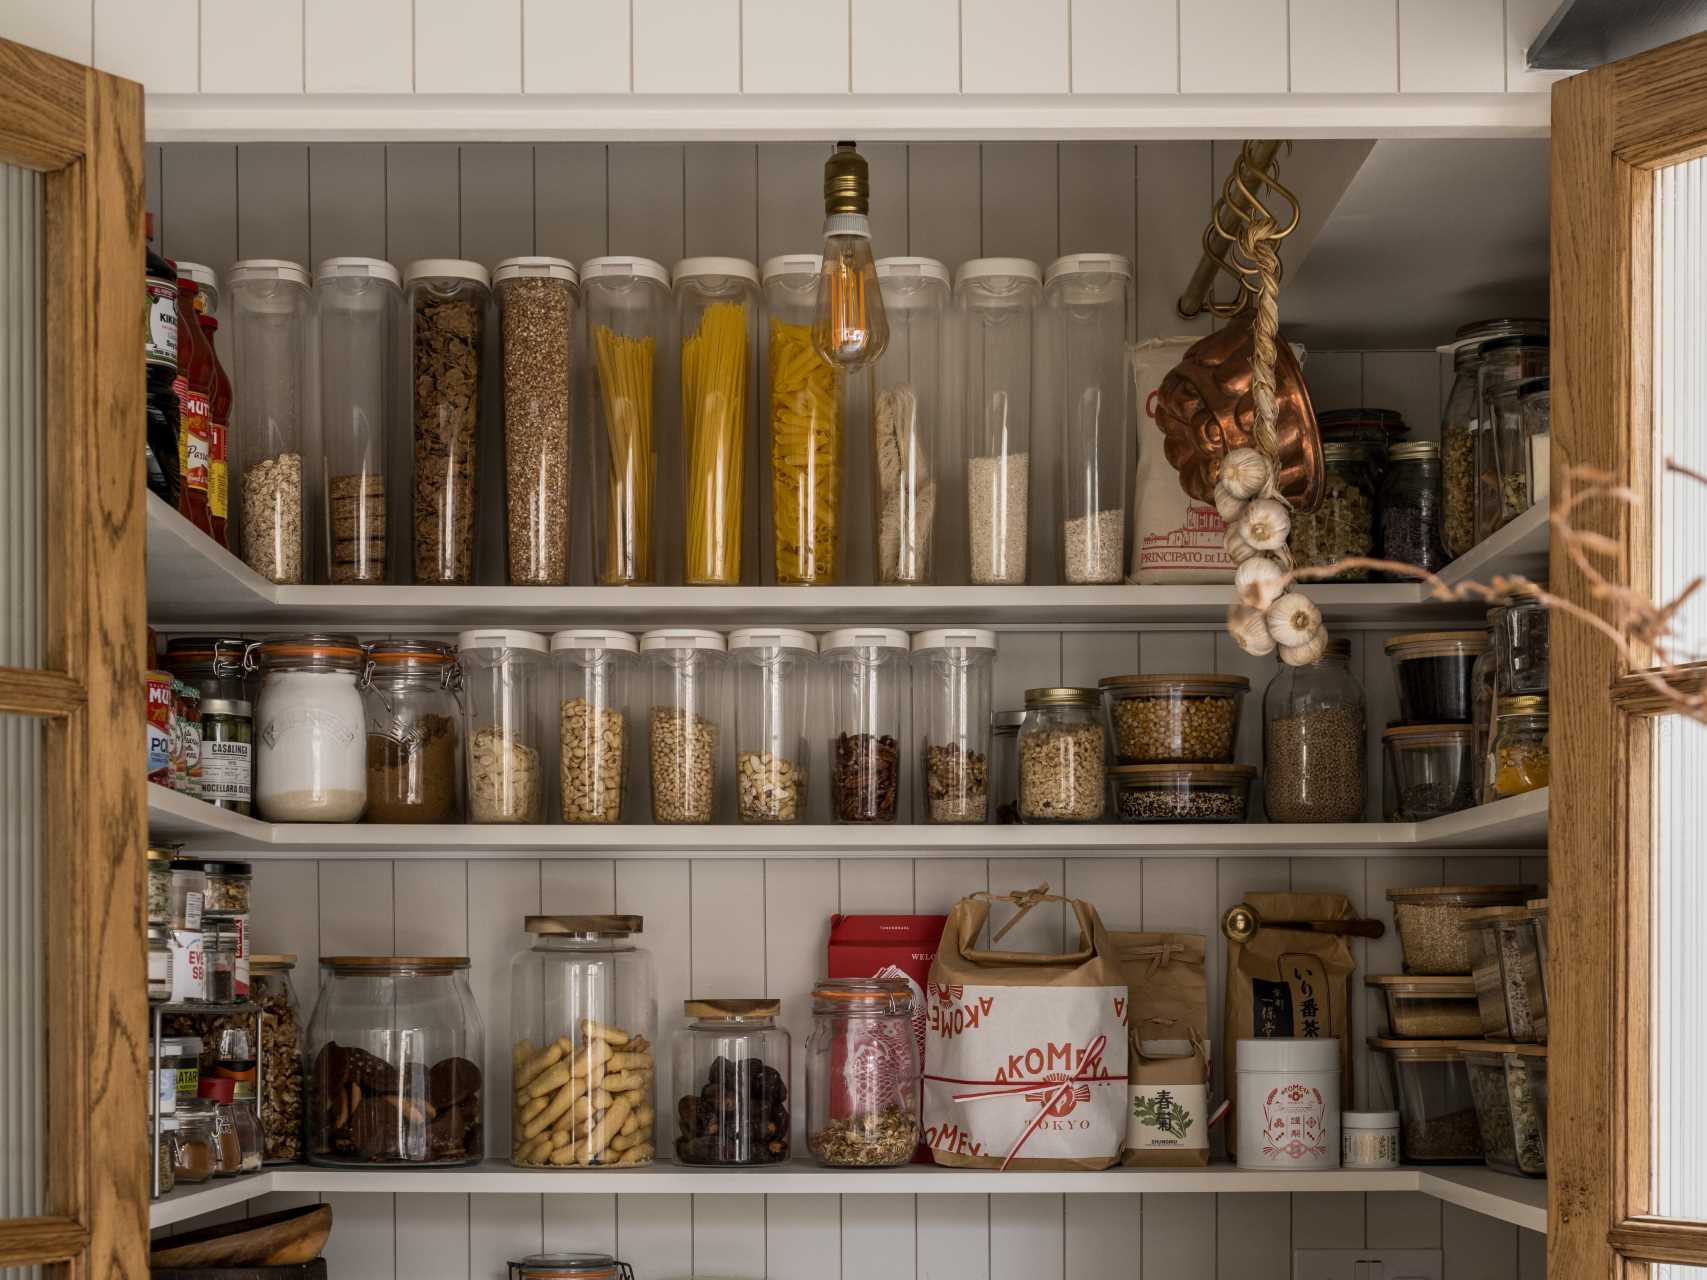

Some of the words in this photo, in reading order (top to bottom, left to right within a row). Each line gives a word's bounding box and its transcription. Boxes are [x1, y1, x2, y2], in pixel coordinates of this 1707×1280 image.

[1141, 551, 1201, 562] PRINCIPATO
[211, 743, 248, 755] CASALINGA
[201, 783, 238, 793] NOCELLARA
[1152, 1089, 1174, 1131] 春菊
